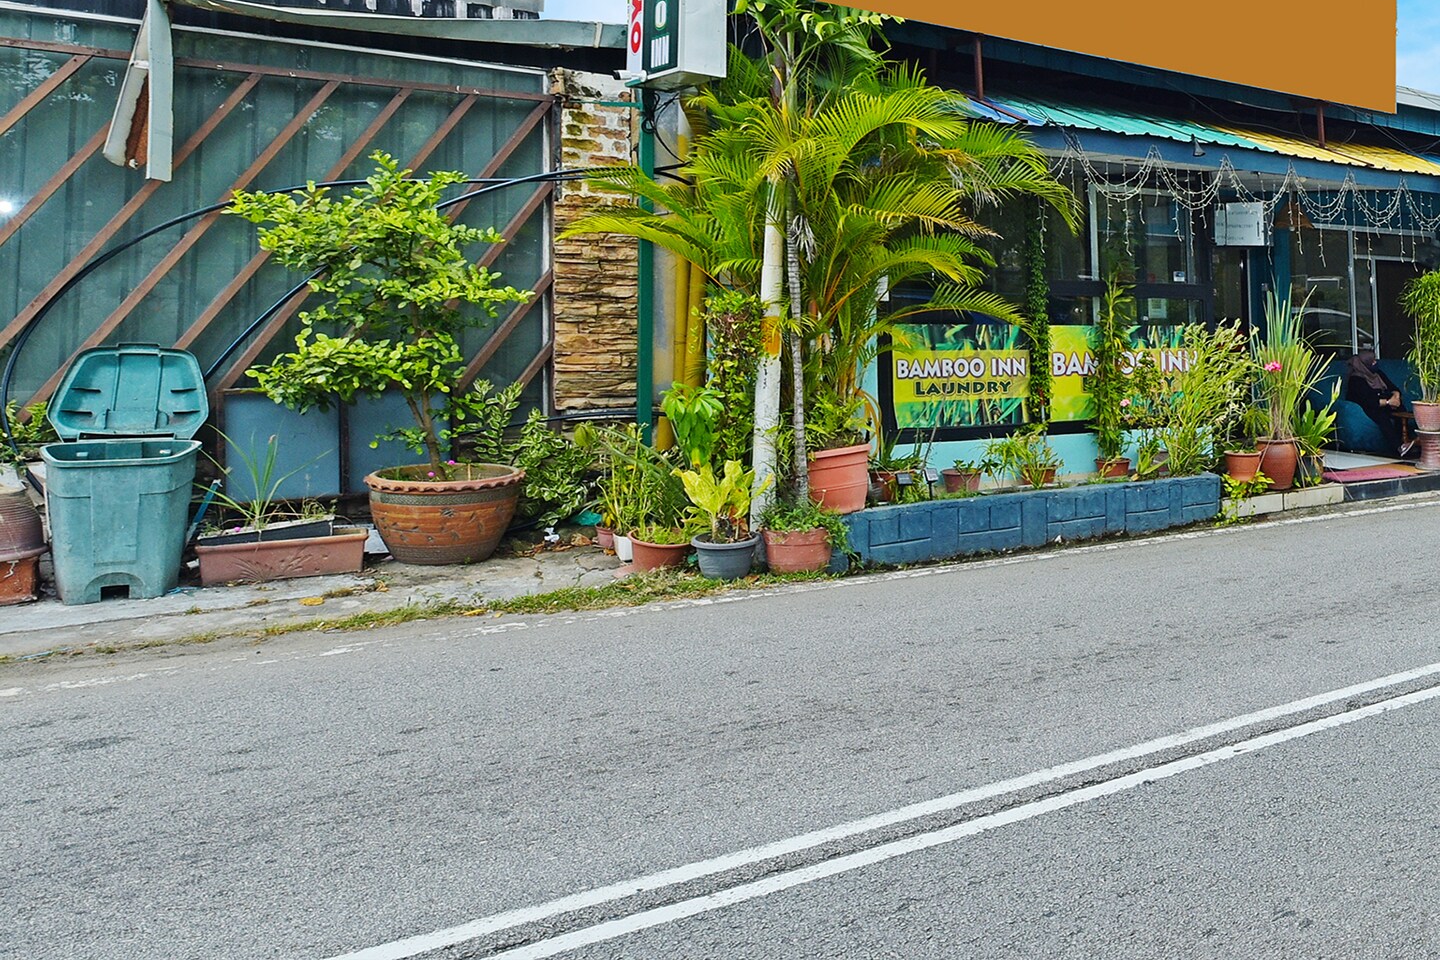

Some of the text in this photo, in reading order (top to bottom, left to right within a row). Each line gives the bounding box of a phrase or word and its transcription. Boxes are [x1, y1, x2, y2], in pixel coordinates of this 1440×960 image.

[897, 358, 1026, 379] BAMBOO INN
[915, 381, 1011, 395] LAUNDRY
